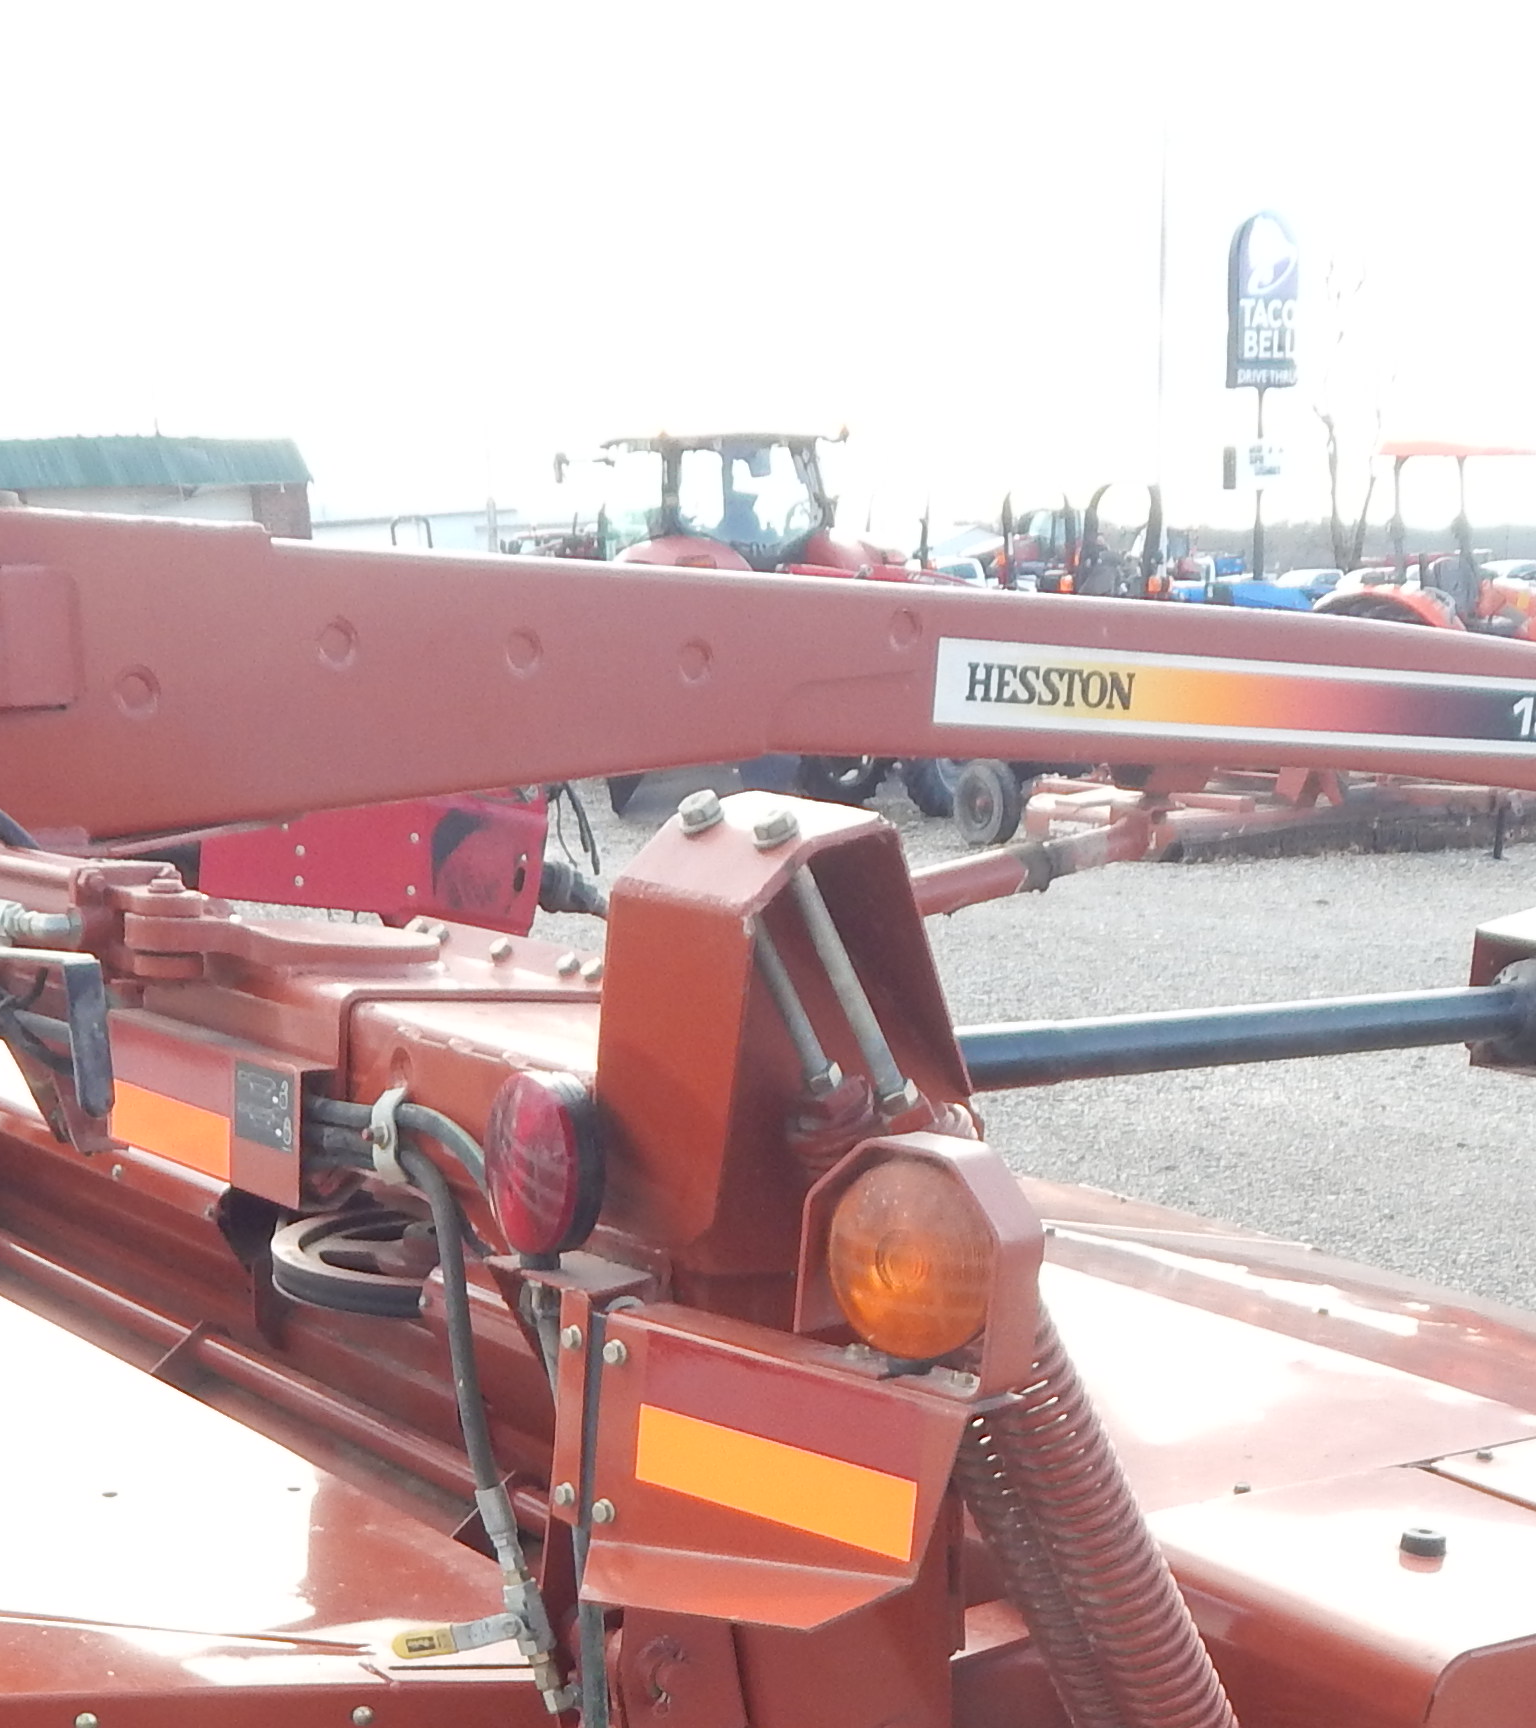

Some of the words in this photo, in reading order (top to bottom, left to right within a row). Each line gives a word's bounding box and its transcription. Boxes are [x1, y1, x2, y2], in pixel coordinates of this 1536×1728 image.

[1239, 299, 1297, 328] TACO
[1243, 330, 1296, 359] BELL
[1237, 368, 1267, 384] DRIVE
[965, 661, 1136, 710] HESSTON
